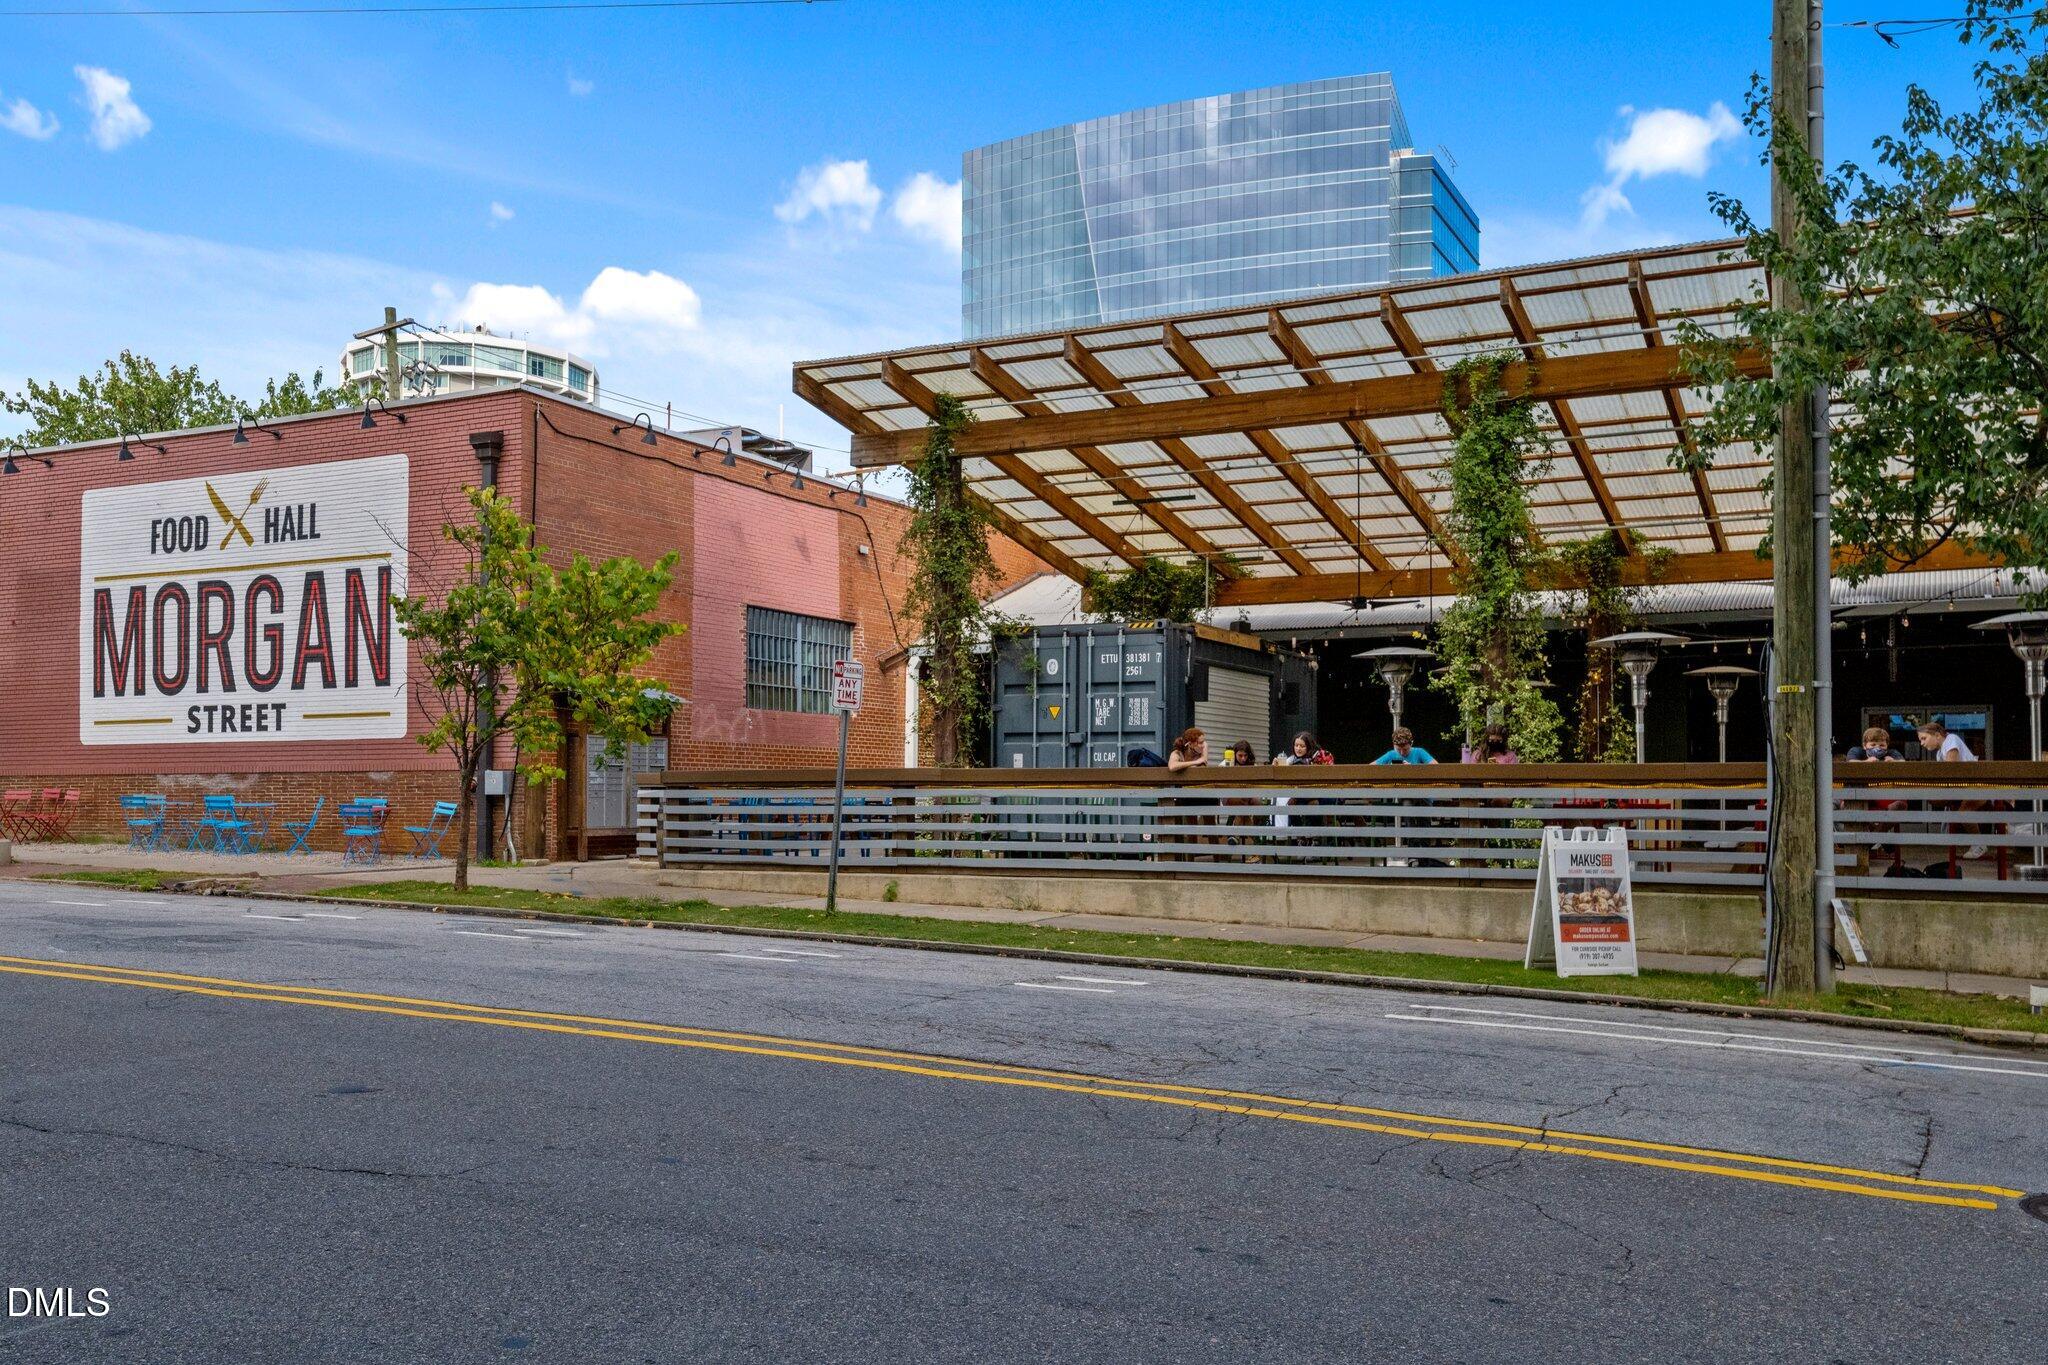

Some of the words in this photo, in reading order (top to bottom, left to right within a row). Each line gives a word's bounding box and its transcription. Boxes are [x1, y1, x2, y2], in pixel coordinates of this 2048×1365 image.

[151, 515, 209, 554] FOOD
[264, 503, 321, 543] HALL
[93, 566, 391, 698] MORGAN
[1101, 654, 1118, 663] ETTU
[1126, 653, 1150, 663] 381381
[1156, 652, 1162, 663] 7
[836, 664, 844, 674] NO
[838, 679, 857, 689] ANY
[837, 690, 858, 701] TIME
[1095, 707, 1111, 717] TARE
[187, 703, 286, 734] STREET
[1095, 716, 1107, 726] NET
[1570, 853, 1601, 867] MAKUS
